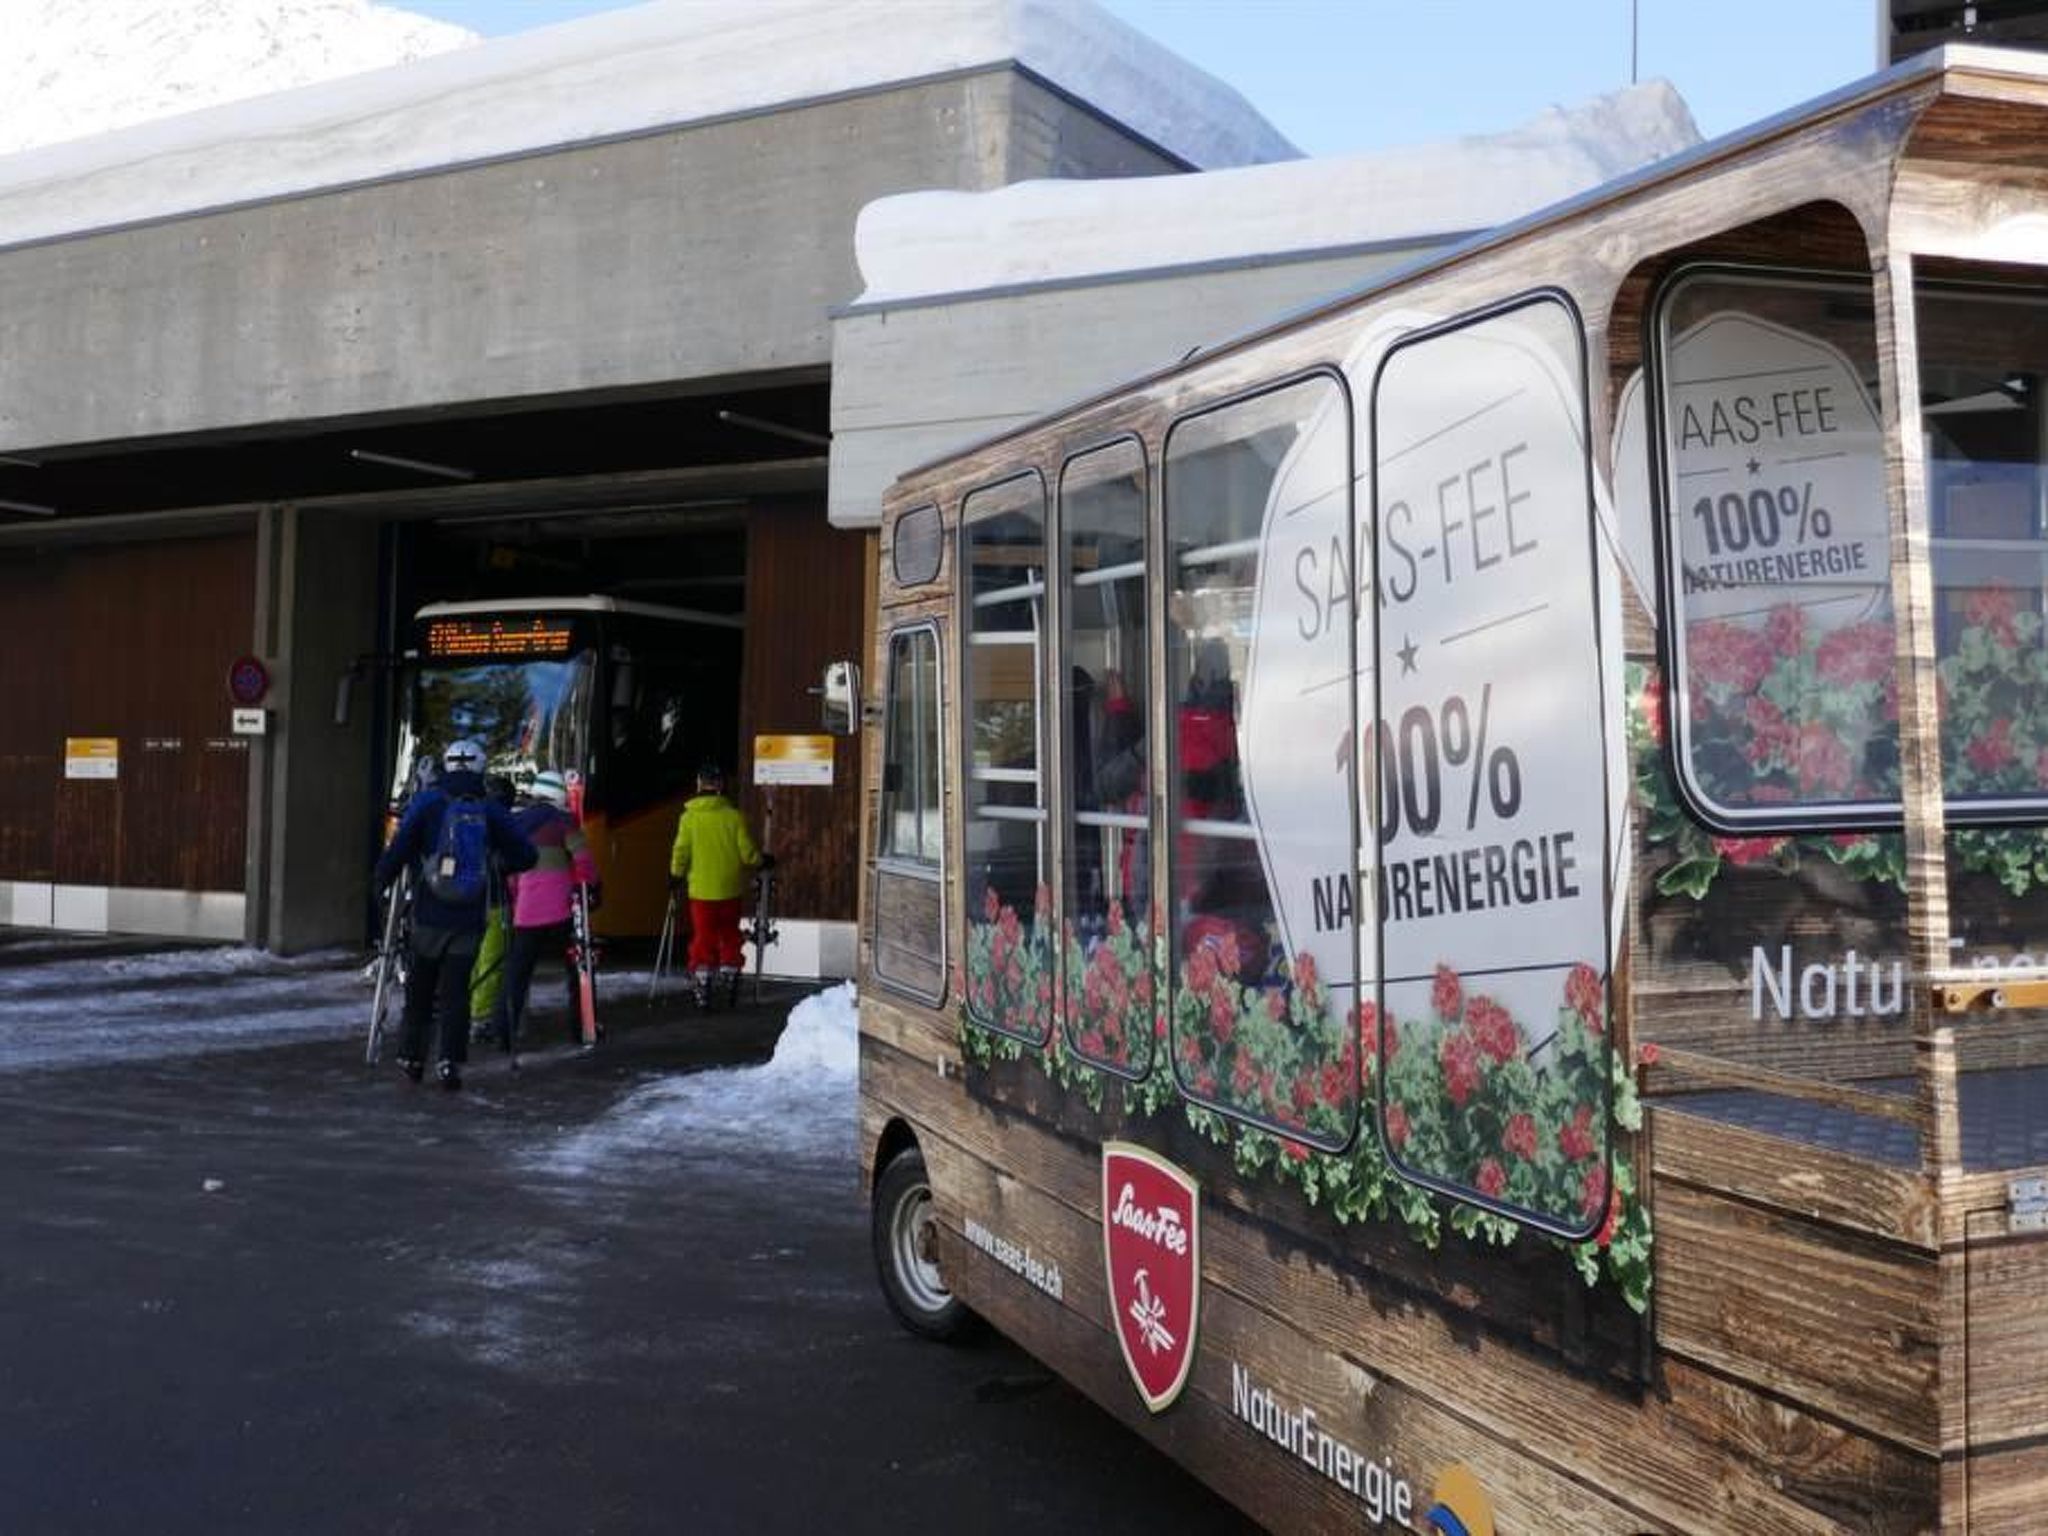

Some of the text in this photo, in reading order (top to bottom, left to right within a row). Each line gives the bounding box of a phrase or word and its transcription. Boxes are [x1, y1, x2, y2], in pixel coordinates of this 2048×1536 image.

[1675, 386, 1838, 450] AAS-FEE
[1295, 442, 1538, 642] SAAS-FEE
[1693, 481, 1832, 555] 100%
[1336, 683, 1522, 847] 100%
[1312, 831, 1580, 933] NATURENERGIE
[1232, 1362, 1413, 1528] NaturEnergie
